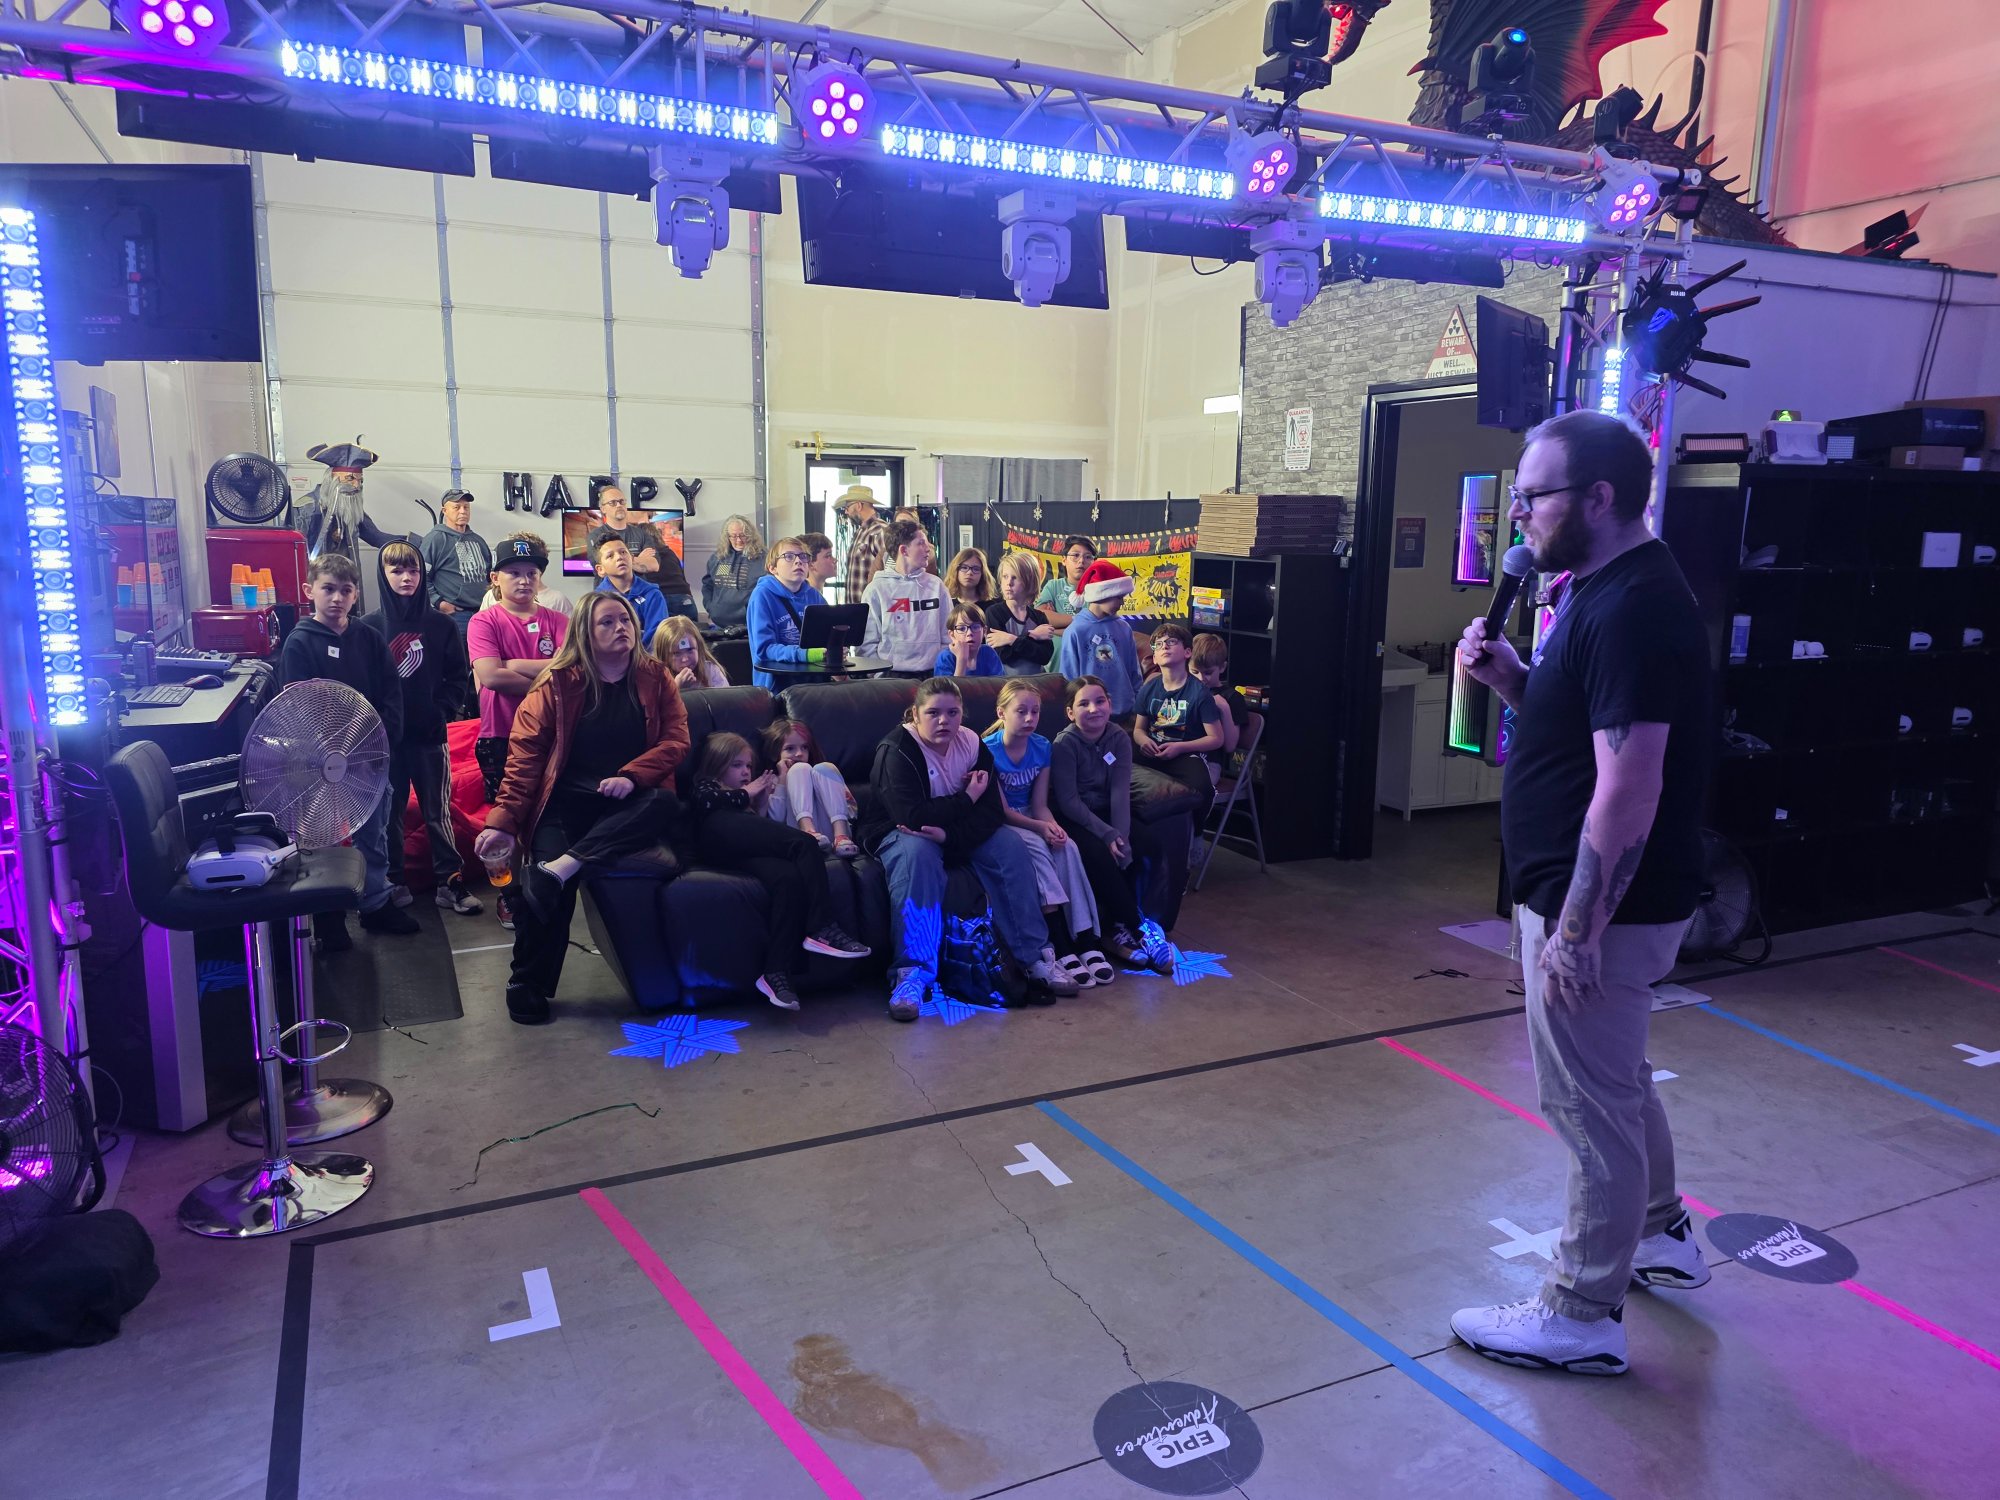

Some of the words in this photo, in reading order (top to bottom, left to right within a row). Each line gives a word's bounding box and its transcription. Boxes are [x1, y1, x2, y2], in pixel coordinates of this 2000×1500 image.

[1441, 336, 1466, 348] BEWARE
[1446, 347, 1461, 356] OF...
[503, 471, 703, 518] HAPPY
[1107, 538, 1151, 557] WARNING
[887, 597, 940, 613] A10
[999, 766, 1040, 786] POSITIVE
[1770, 1243, 1814, 1262] EPIC
[1115, 1395, 1218, 1457] Adventures
[1156, 1429, 1215, 1459] EPIC
